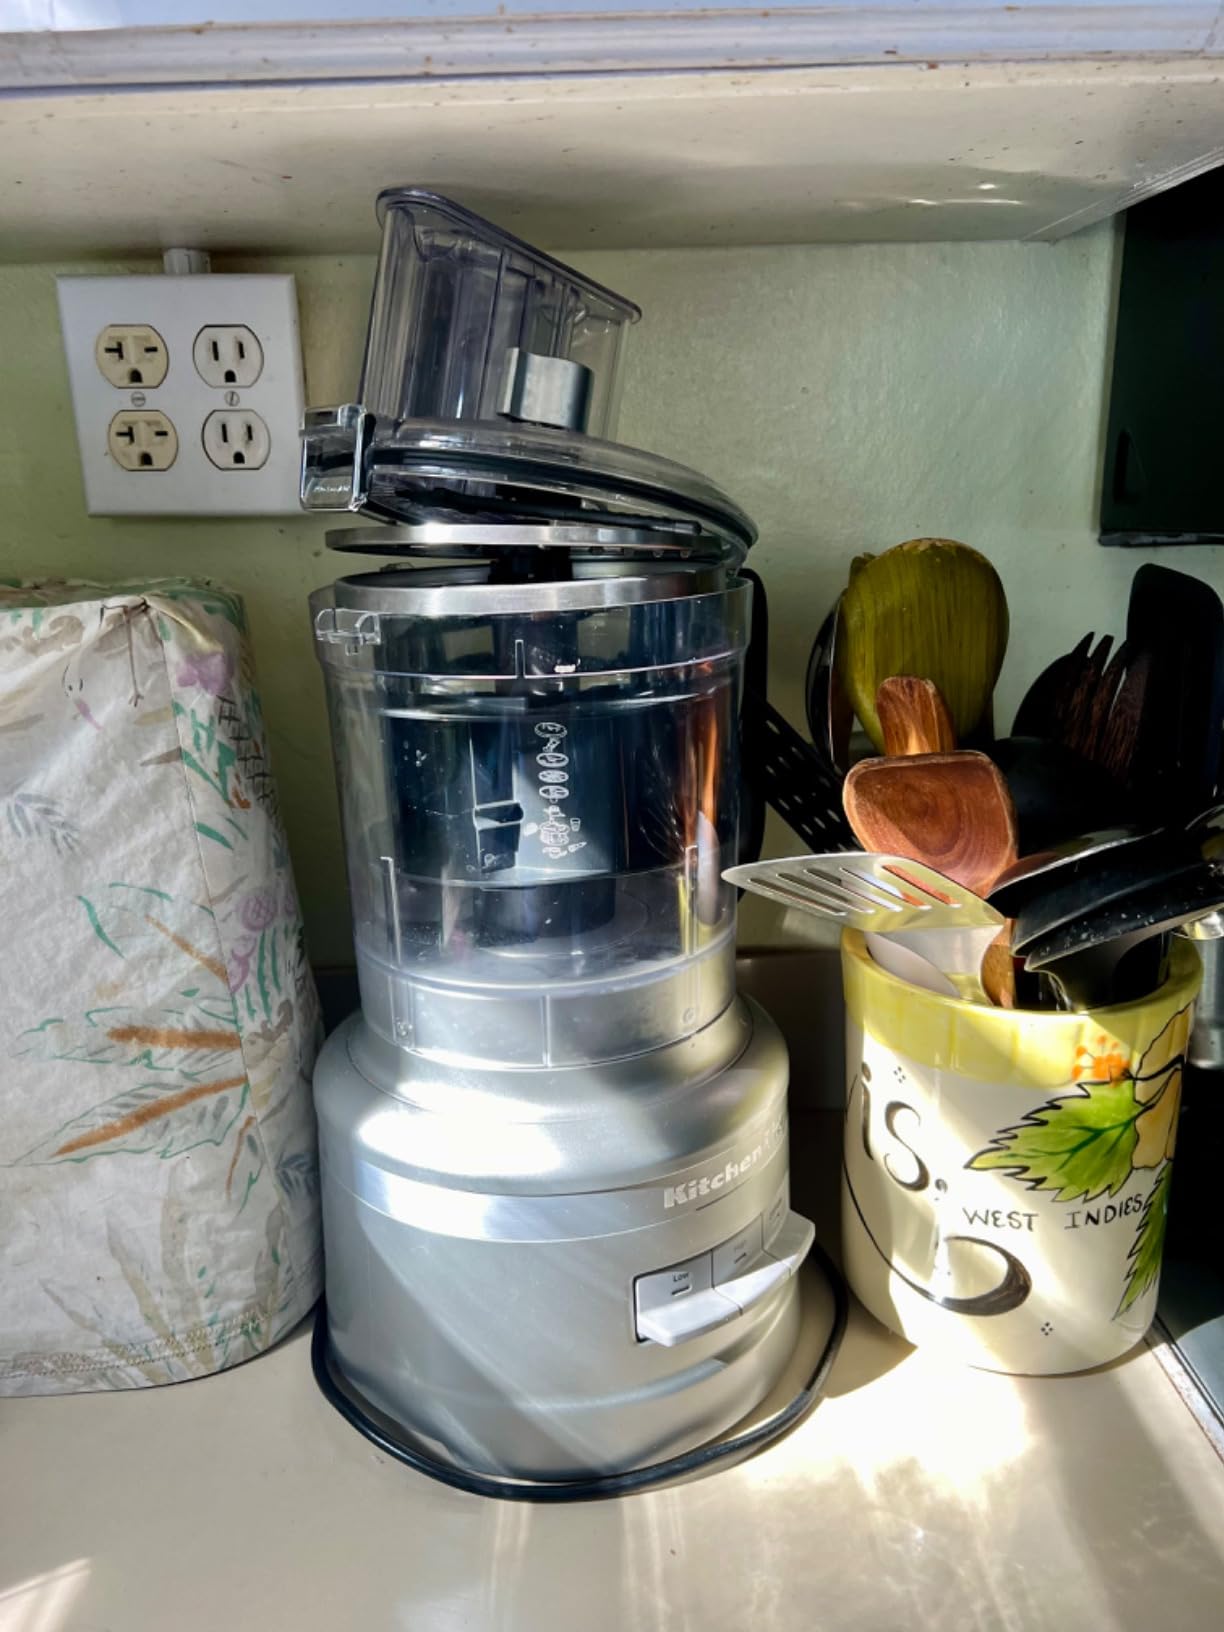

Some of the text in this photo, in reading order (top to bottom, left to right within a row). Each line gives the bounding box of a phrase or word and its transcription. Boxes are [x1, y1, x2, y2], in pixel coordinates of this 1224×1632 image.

[663, 1119, 786, 1209] Kitchen
[962, 1193, 1143, 1232] WEST INDIES
